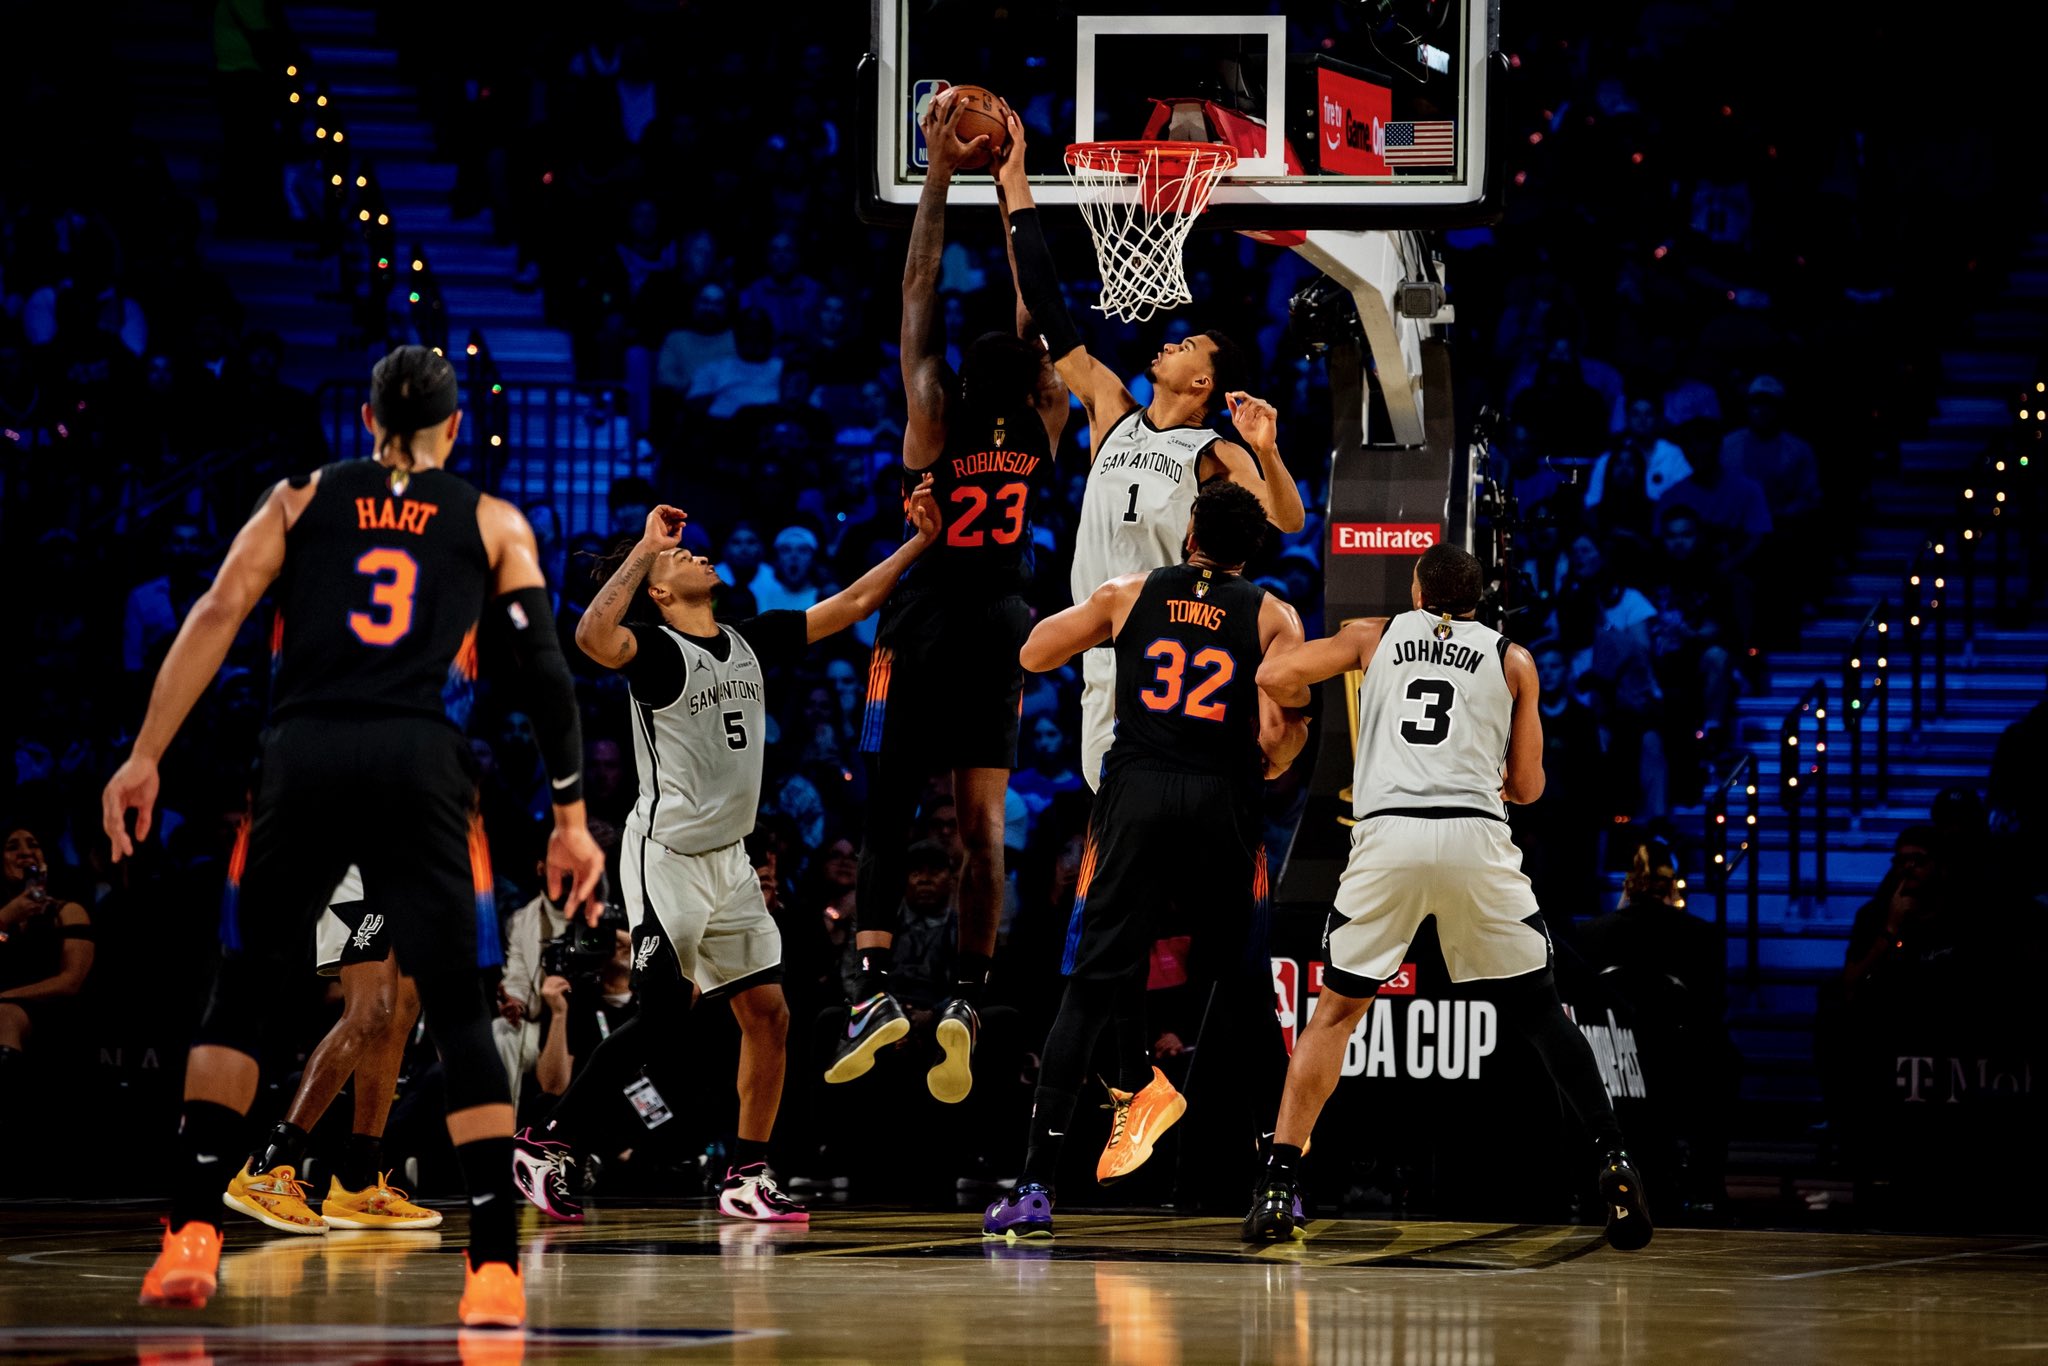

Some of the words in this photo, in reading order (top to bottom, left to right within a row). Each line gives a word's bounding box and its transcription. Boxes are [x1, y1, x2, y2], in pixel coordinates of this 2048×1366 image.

[952, 450, 1041, 478] ROBINSON
[1100, 450, 1131, 475] SAN
[1128, 451, 1184, 485] ANTONIO
[355, 496, 439, 536] HART
[946, 481, 1030, 547] 23
[1121, 482, 1141, 523] 1
[1339, 526, 1434, 549] Emirates
[346, 546, 421, 646] 3
[1166, 598, 1227, 631] TOWNS
[1392, 638, 1486, 674] JOHNSON
[1139, 636, 1238, 722] 32
[689, 685, 718, 716] SAN
[1399, 676, 1458, 747] 3
[721, 709, 750, 752] 5
[1306, 997, 1397, 1078] BA
[1406, 999, 1498, 1080] CUP
